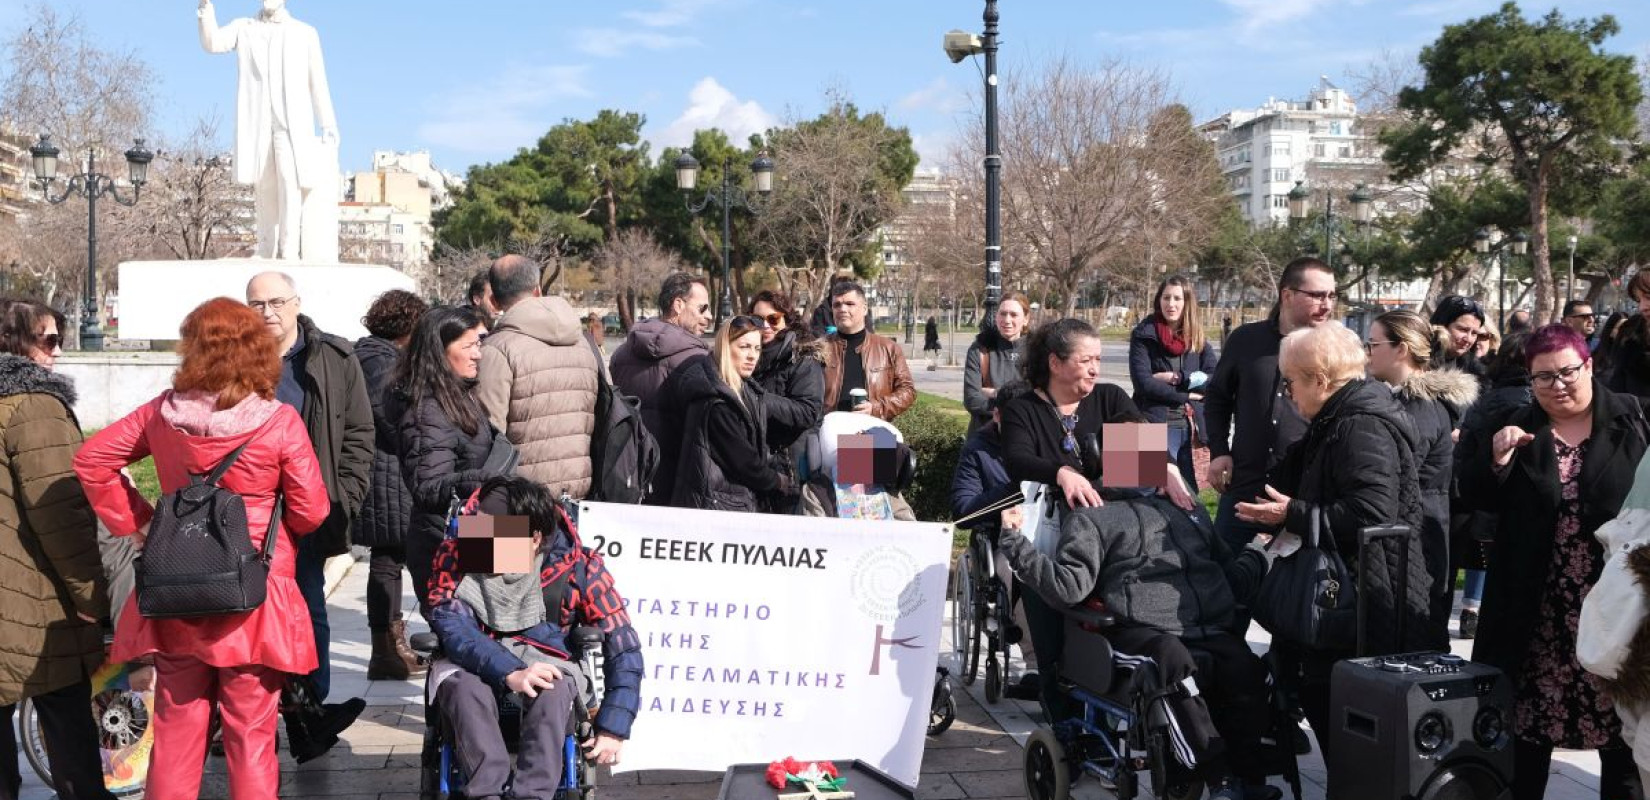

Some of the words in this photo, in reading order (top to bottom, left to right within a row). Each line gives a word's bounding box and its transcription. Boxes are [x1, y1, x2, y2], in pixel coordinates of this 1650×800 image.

[639, 536, 715, 563] ΕΕΕΕΚ
[721, 542, 829, 570] ΠΥΛΑΙΑΣ
[621, 597, 771, 621] ΡΓΑΣΤΗΡΙΟ
[642, 664, 845, 688] ΓΓΕΛΜΑΤΙΚΗΣ
[639, 696, 784, 718] ΑΙΔΕΥΣΗΣ
